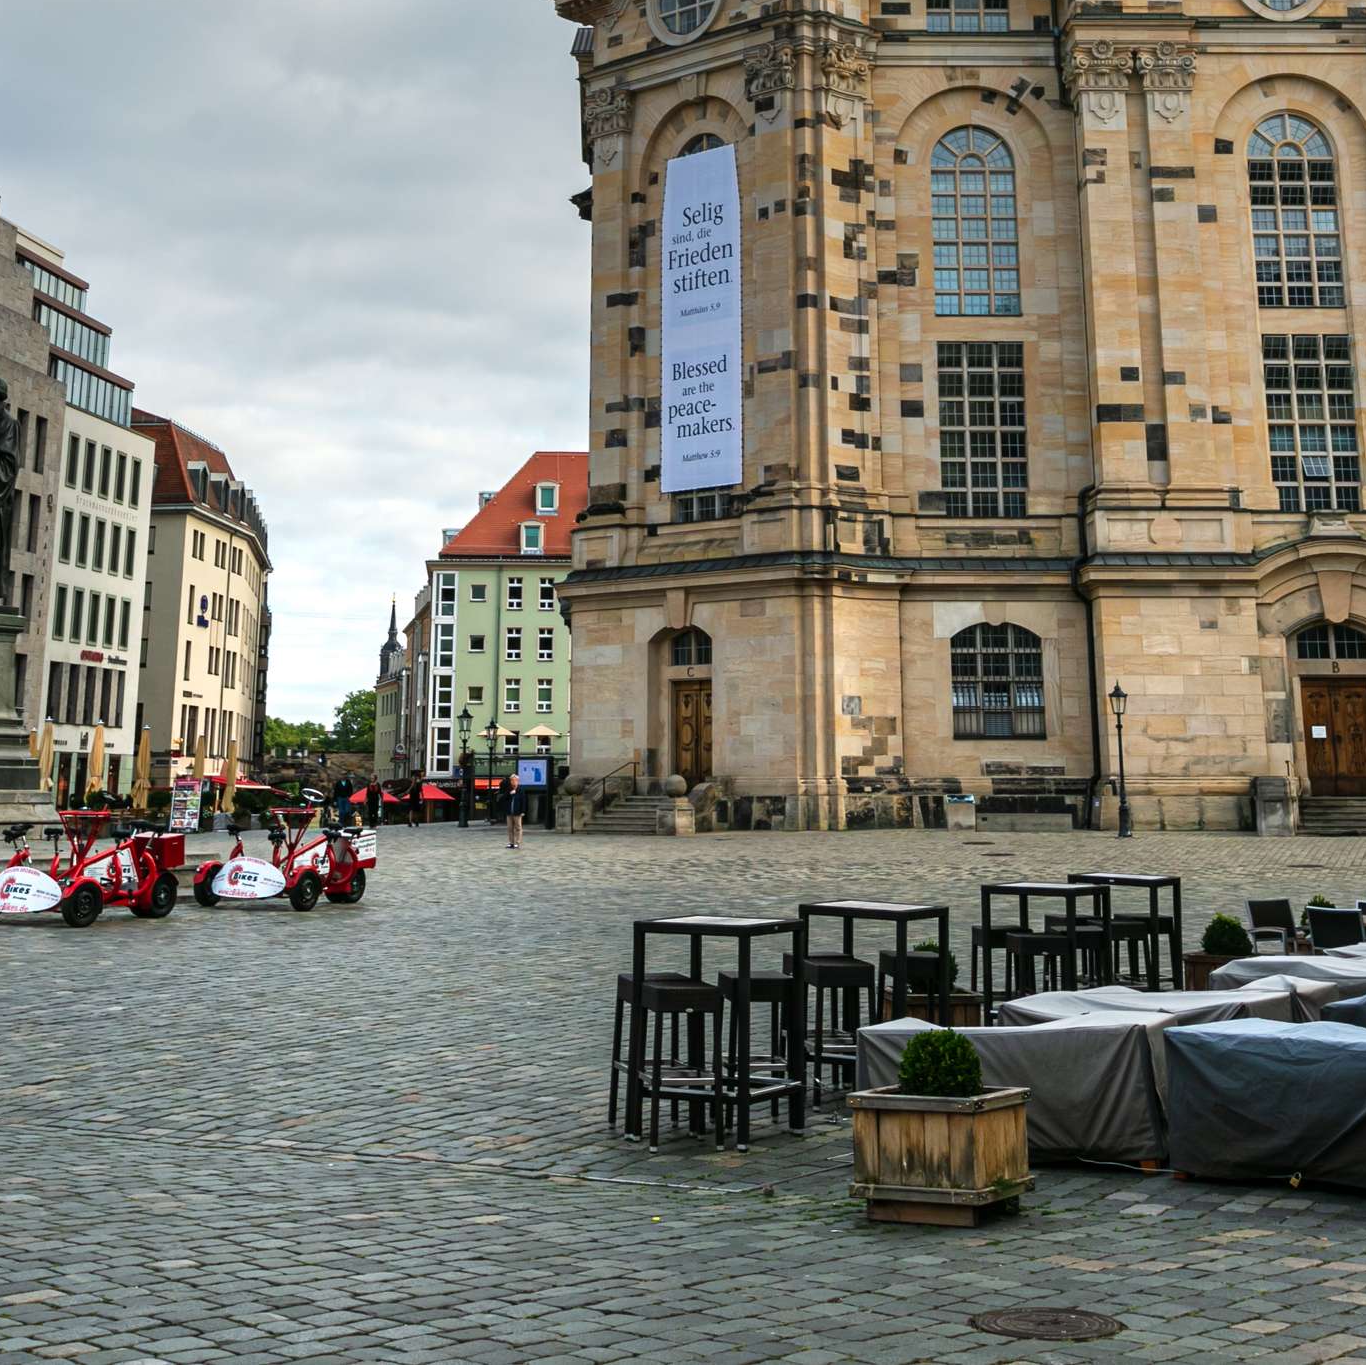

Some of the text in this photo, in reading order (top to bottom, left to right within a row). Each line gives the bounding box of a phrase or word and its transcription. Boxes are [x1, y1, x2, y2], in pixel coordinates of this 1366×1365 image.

[682, 202, 724, 227] Selig
[672, 227, 712, 245] sind, die
[668, 242, 734, 270] Frieden
[673, 268, 733, 295] stiften.
[672, 354, 728, 381] Blessed
[682, 381, 715, 396] are the
[668, 398, 717, 425] peace-
[676, 416, 736, 439] makers.
[687, 666, 695, 677] C
[1332, 661, 1340, 673] B
